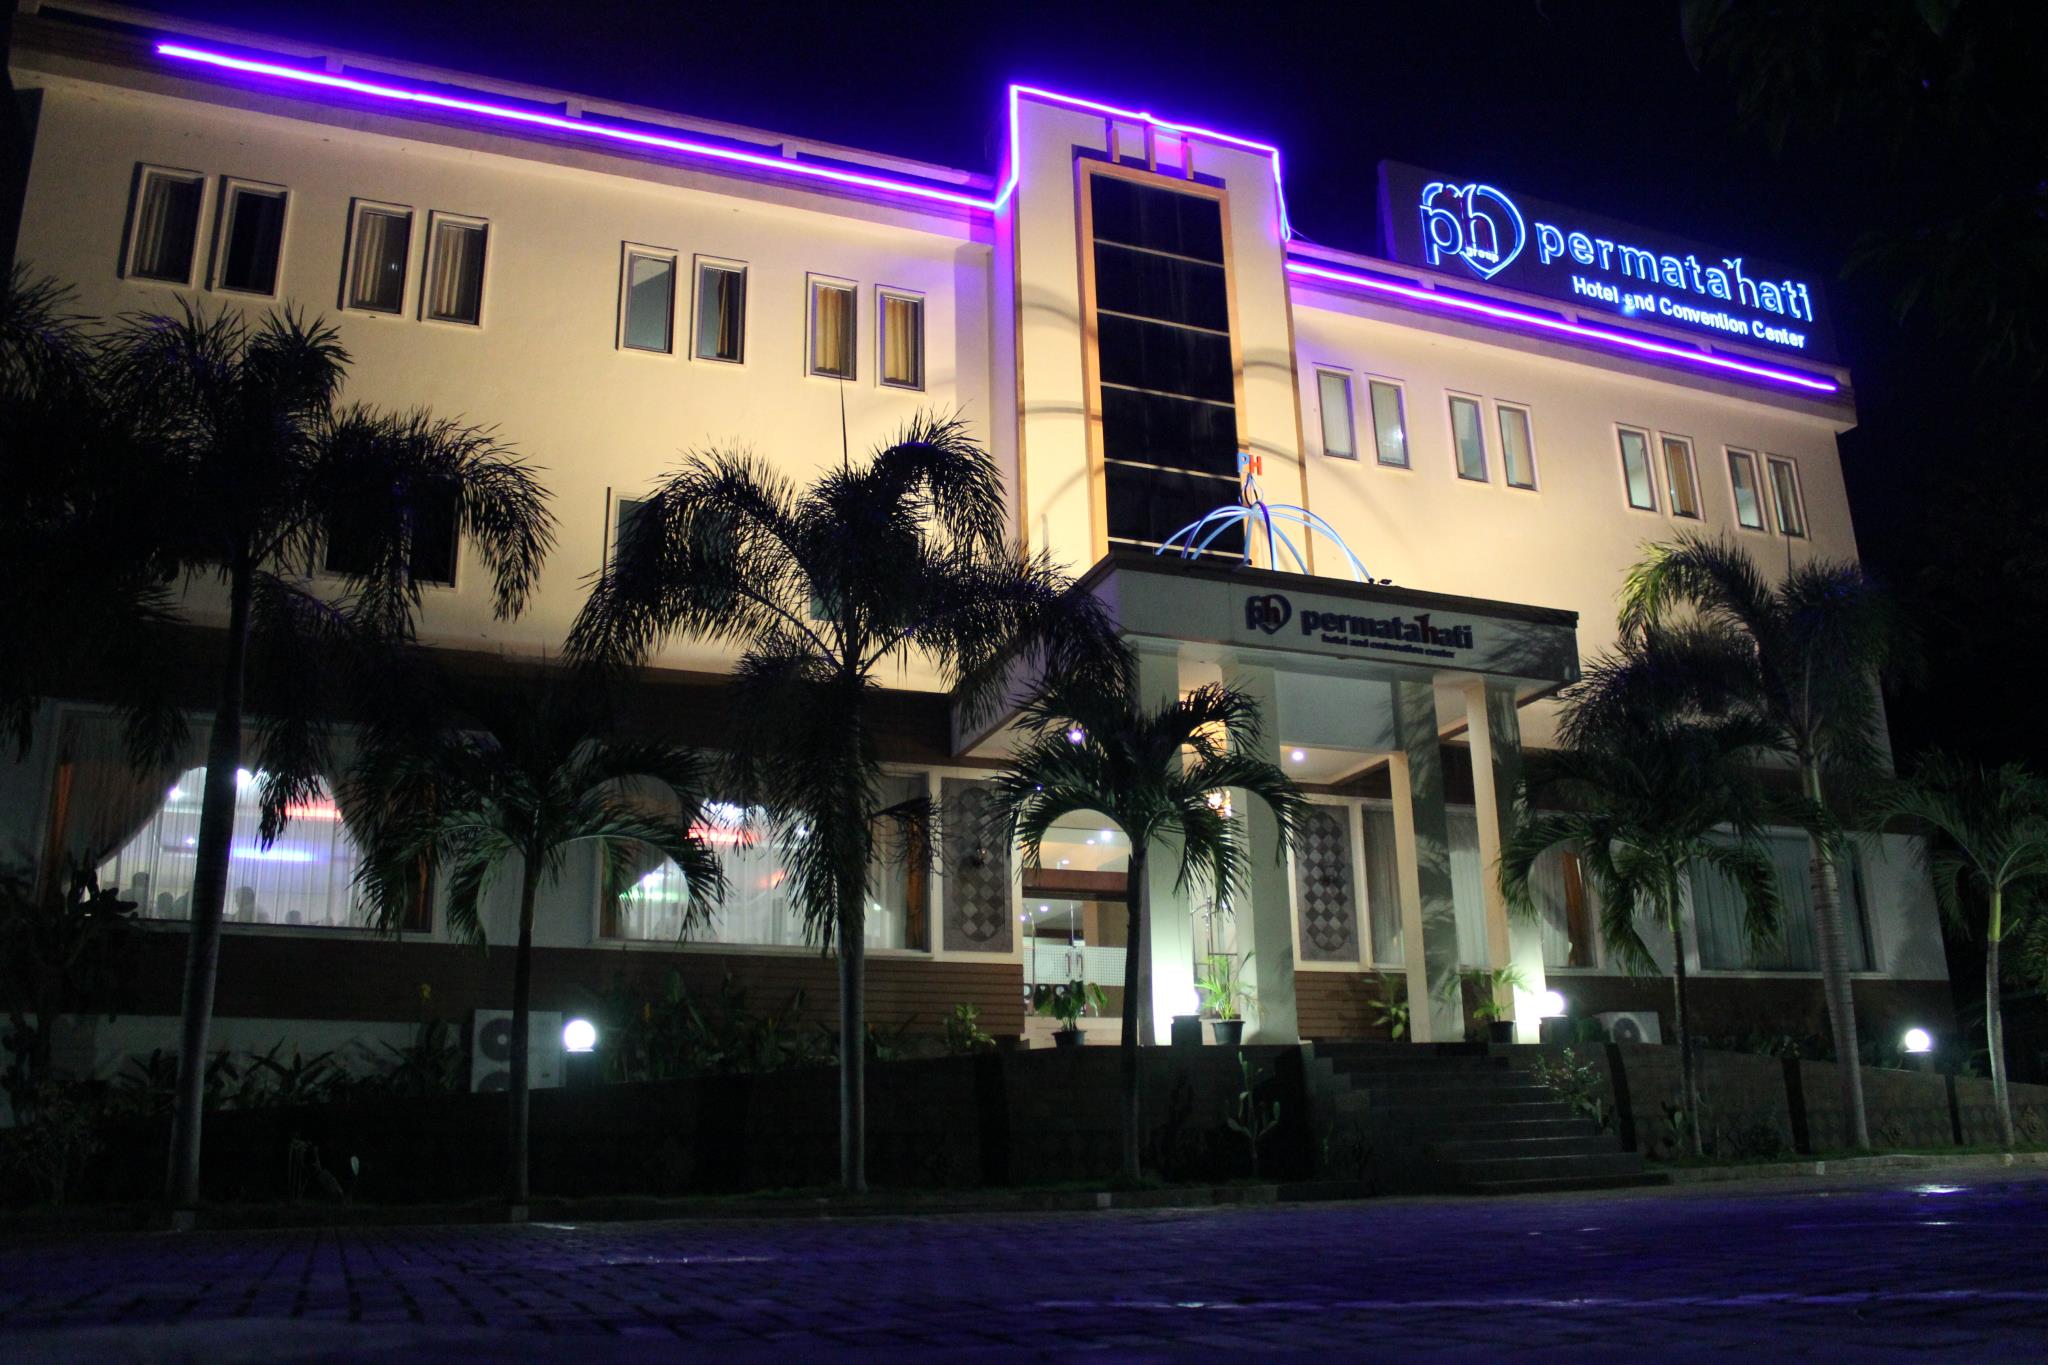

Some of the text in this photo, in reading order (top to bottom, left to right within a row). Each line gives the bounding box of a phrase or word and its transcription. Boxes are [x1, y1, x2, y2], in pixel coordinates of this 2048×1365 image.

[1535, 221, 1814, 323] permatahati
[1571, 274, 1806, 349] Hotel and Convention Center
[1237, 451, 1263, 476] PH
[1301, 609, 1474, 650] permatahati
